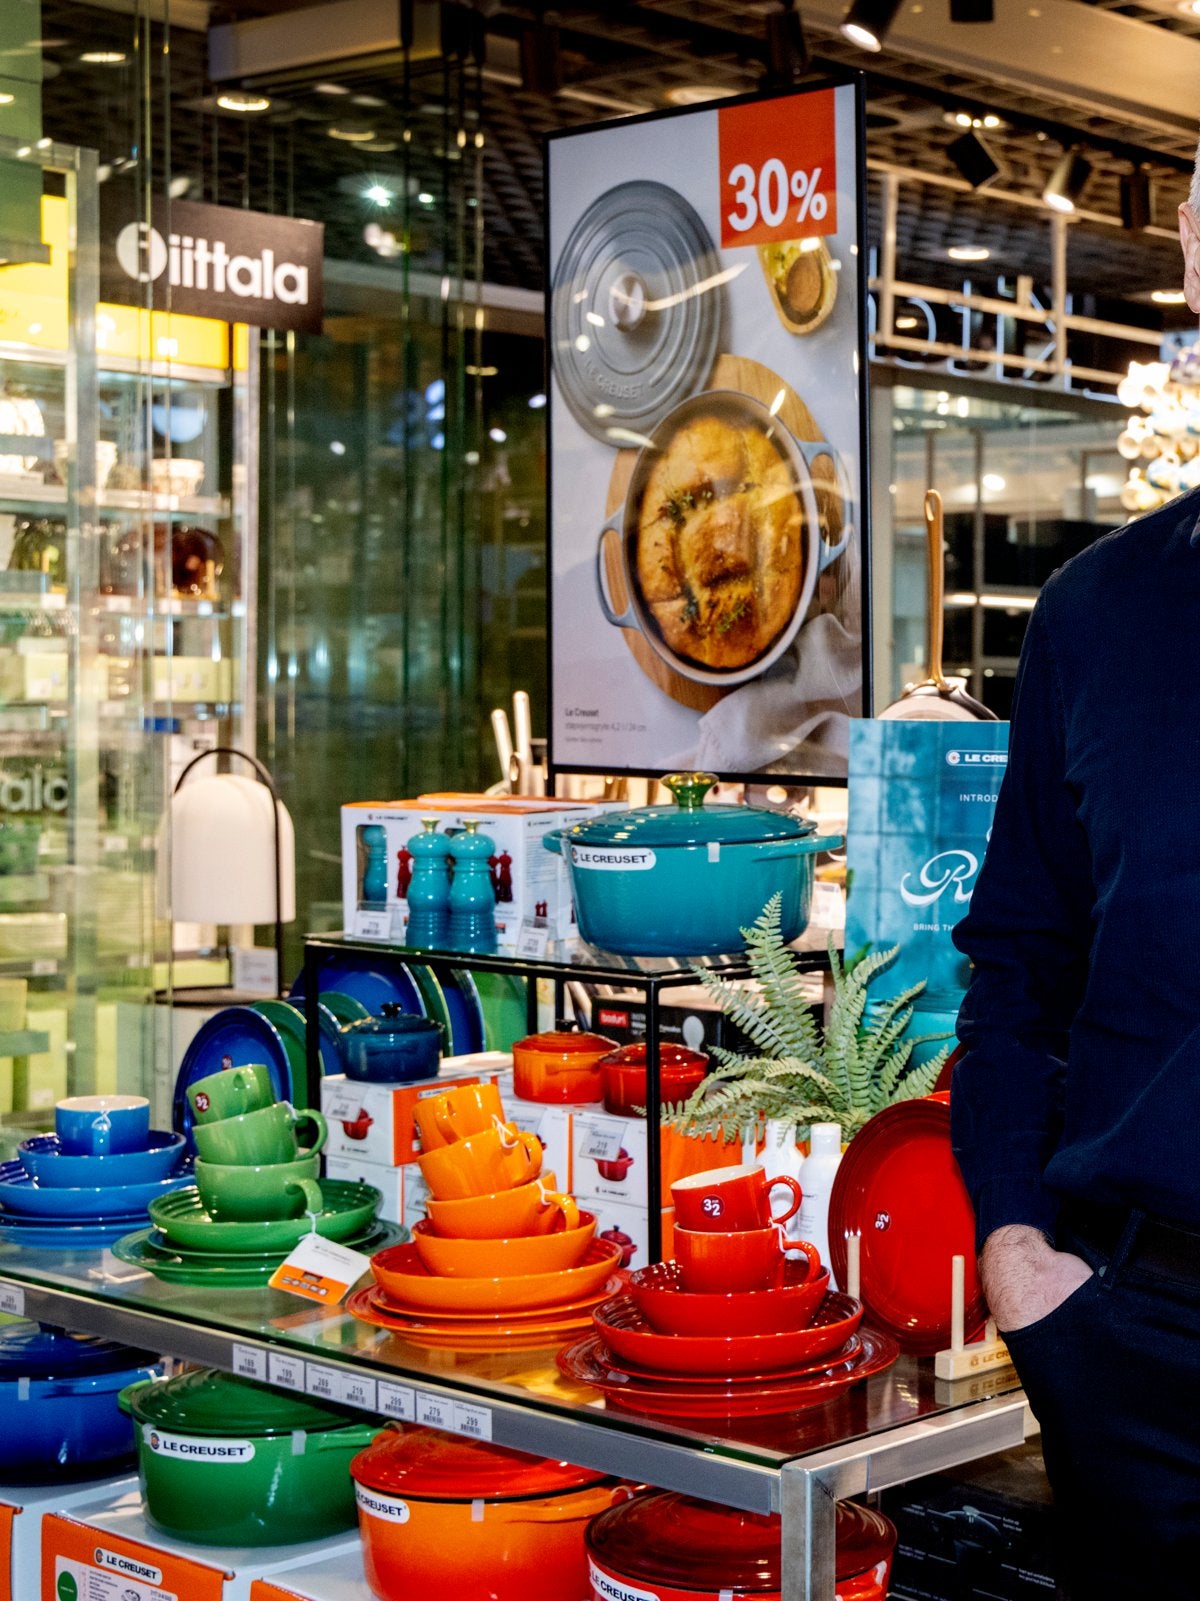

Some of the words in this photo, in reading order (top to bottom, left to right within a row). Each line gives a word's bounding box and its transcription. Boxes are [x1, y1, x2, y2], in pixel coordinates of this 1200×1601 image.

[727, 158, 828, 232] 30%
[168, 233, 309, 305] iittala
[964, 754, 980, 763] LE
[580, 853, 591, 863] LE
[592, 854, 647, 864] CREUSET
[913, 923, 939, 932] BRING
[703, 1198, 712, 1211] 3
[163, 1440, 178, 1451] LE
[179, 1444, 246, 1456] CREUSET
[362, 1496, 402, 1516] CREUSET
[106, 1555, 117, 1566] LE
[118, 1559, 157, 1580] CREUSET
[592, 1569, 600, 1586] LE
